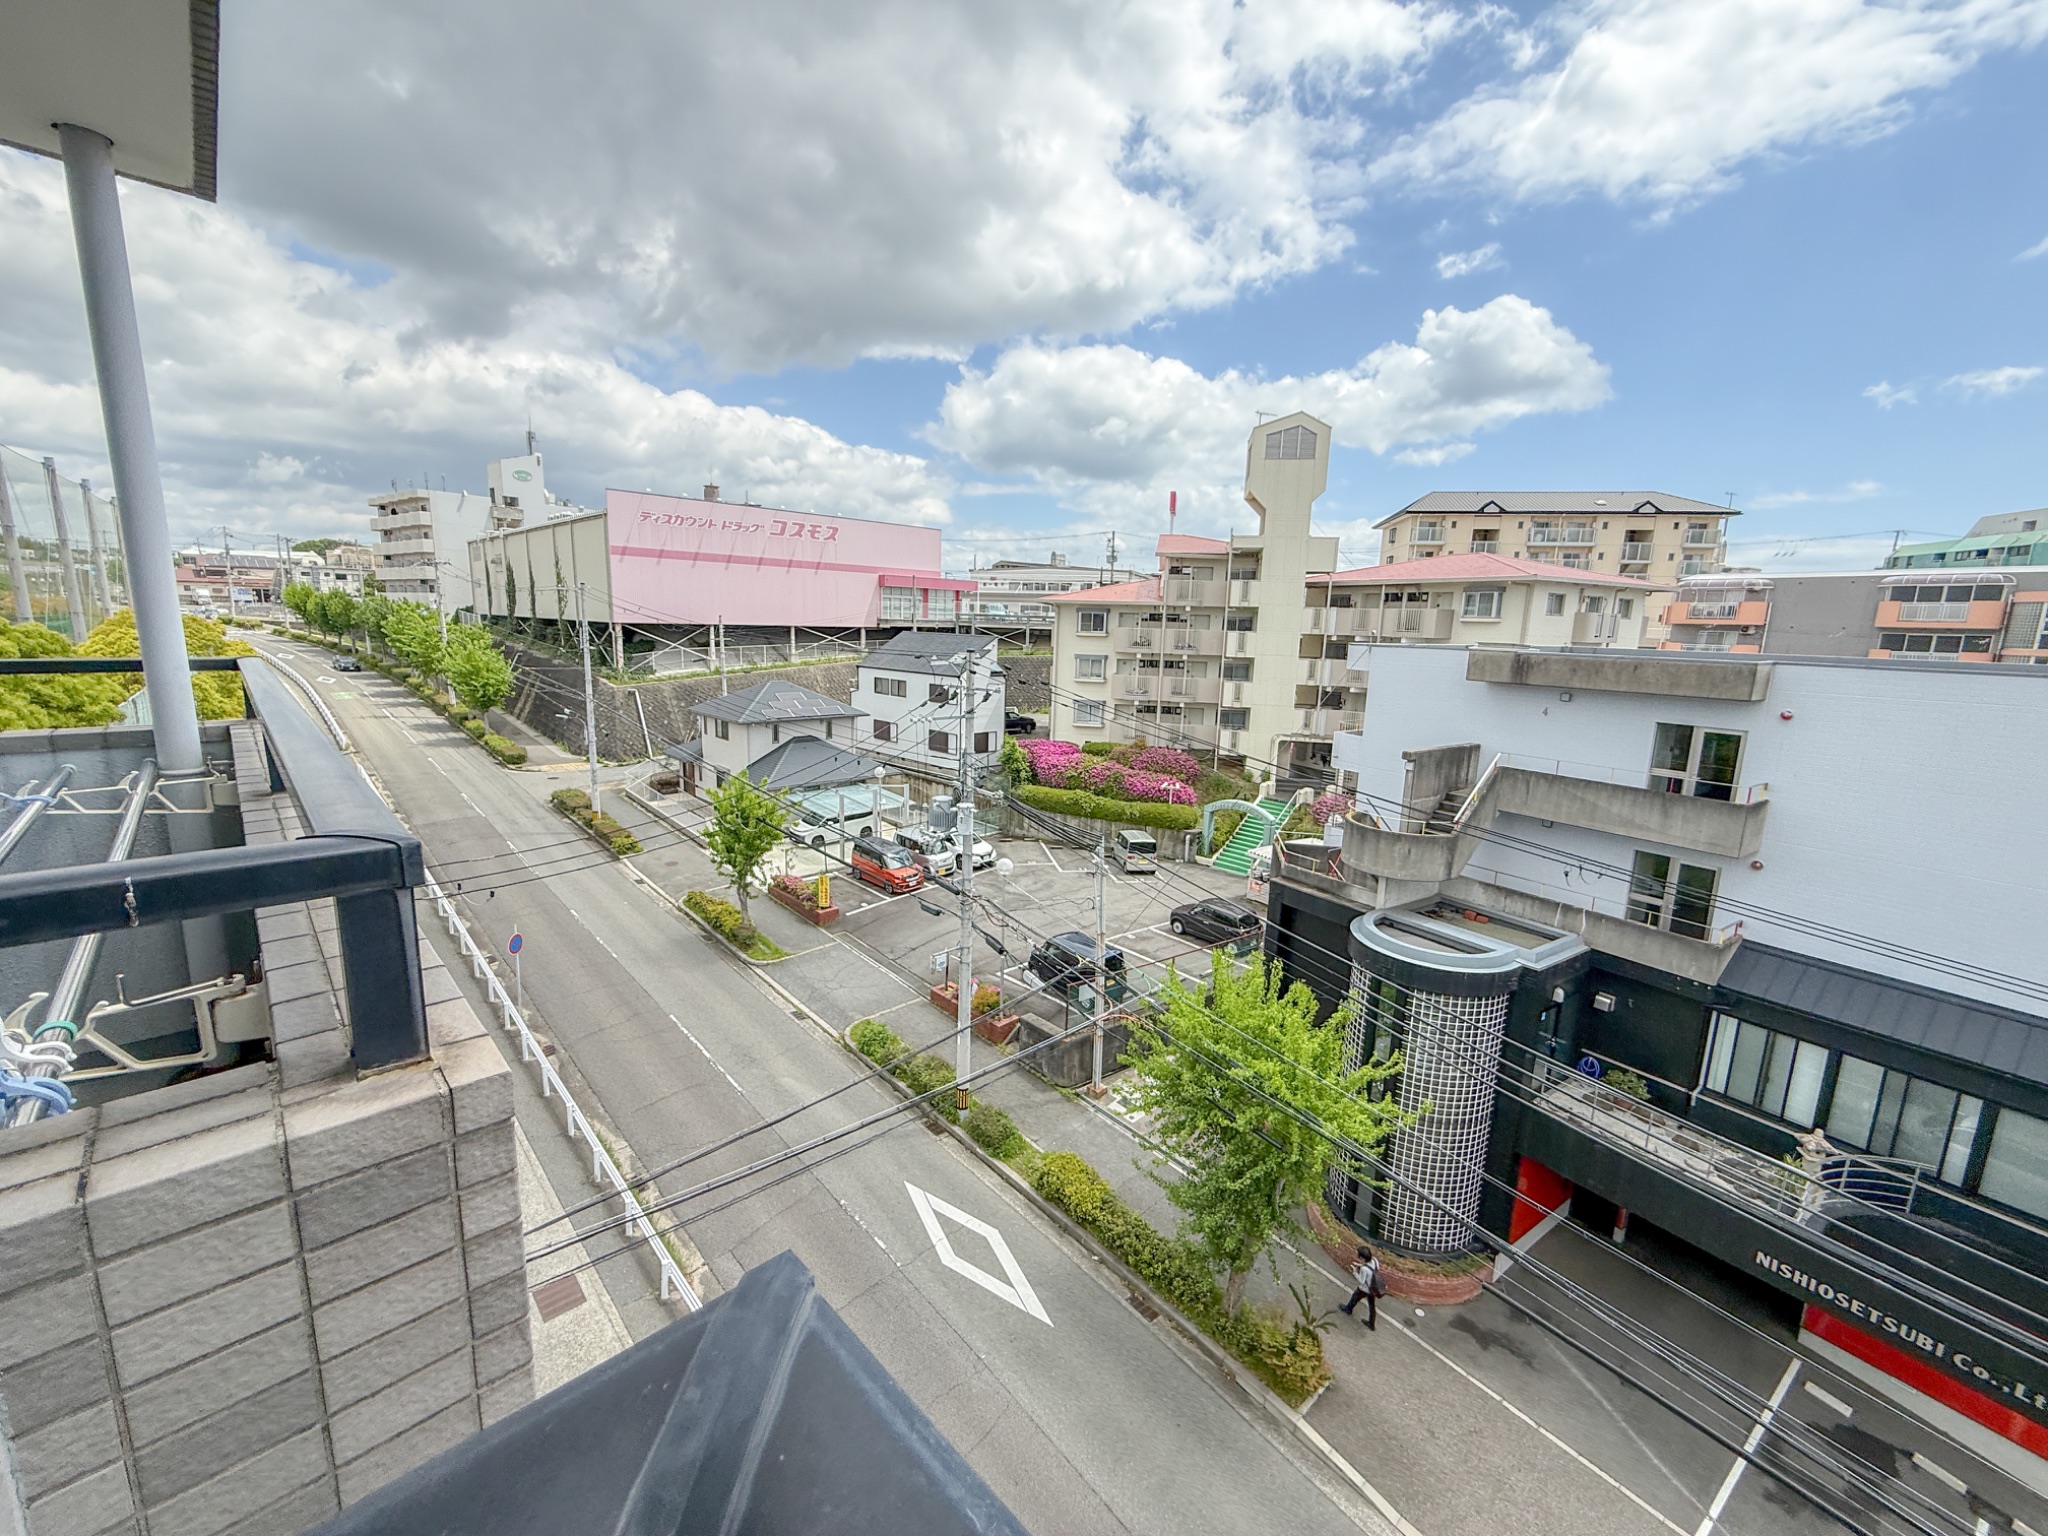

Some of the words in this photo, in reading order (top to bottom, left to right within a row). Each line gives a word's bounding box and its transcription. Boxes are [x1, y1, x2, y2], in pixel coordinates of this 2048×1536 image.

[639, 511, 717, 529] ディスカウント
[721, 520, 765, 533] ドラッグ
[769, 519, 839, 542] コスモス
[1755, 1251, 1945, 1358] NISHIOSETSUBI
[1952, 1353, 2048, 1411] Co.,Lt
